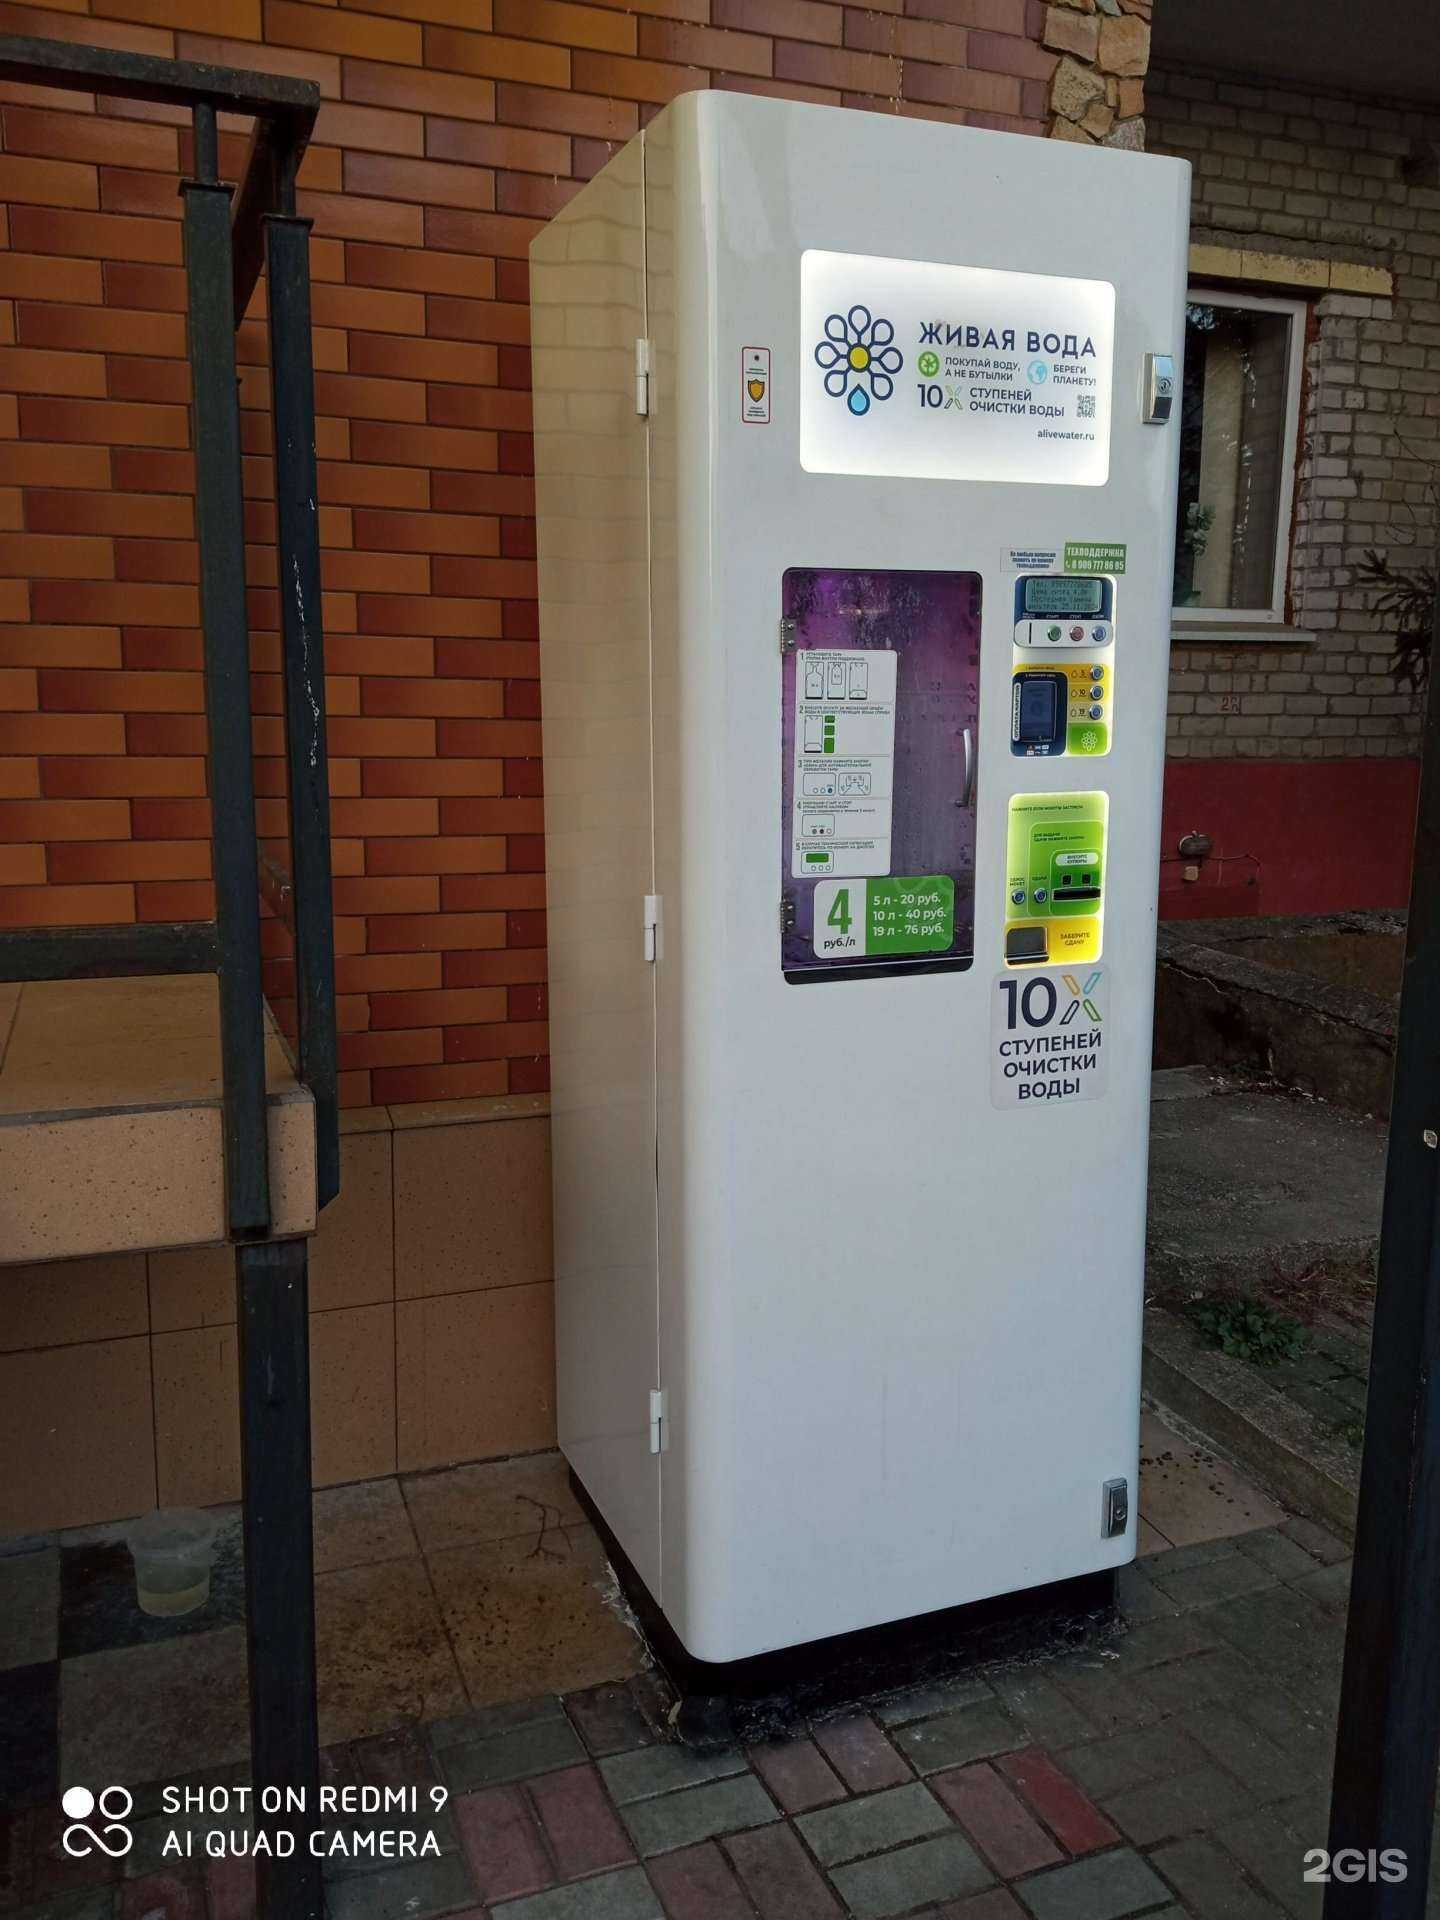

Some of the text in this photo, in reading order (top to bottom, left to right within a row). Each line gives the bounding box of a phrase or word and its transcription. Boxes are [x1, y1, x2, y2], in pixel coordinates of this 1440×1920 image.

[918, 321, 1097, 359] ЖИВАЯ ВОДА
[945, 356, 1021, 372] ПОКУПАЙ ВОДУ,
[1053, 364, 1087, 375] БЕРЕГИ
[945, 369, 1013, 382] А НЕ БУТЫЛКИ
[1053, 376, 1096, 387] ПЛАНЕТУ!
[969, 387, 1032, 401] СТУПЕНЕЙ
[969, 401, 1065, 418] ОЧИСТКИ ВОДЫ
[1037, 429, 1095, 441] alivewater.ru
[1093, 561, 1104, 570] 777
[873, 895, 880, 906] 5
[882, 896, 891, 905] л
[900, 894, 915, 905] 20
[917, 892, 941, 906] руб.
[827, 888, 853, 935] 4
[873, 910, 885, 921] 10
[888, 912, 896, 920] л
[905, 908, 921, 919] 40
[923, 907, 947, 921] руб.
[872, 926, 885, 937] 19
[886, 928, 895, 936] л
[904, 924, 918, 935] 76
[920, 922, 945, 936] руб.
[824, 936, 856, 950] руб./л
[999, 1028, 1102, 1057] СТУПЕНЕЙ
[1003, 1053, 1097, 1078] ОЧИСТКИ
[1018, 1077, 1081, 1100] ВОДЫ
